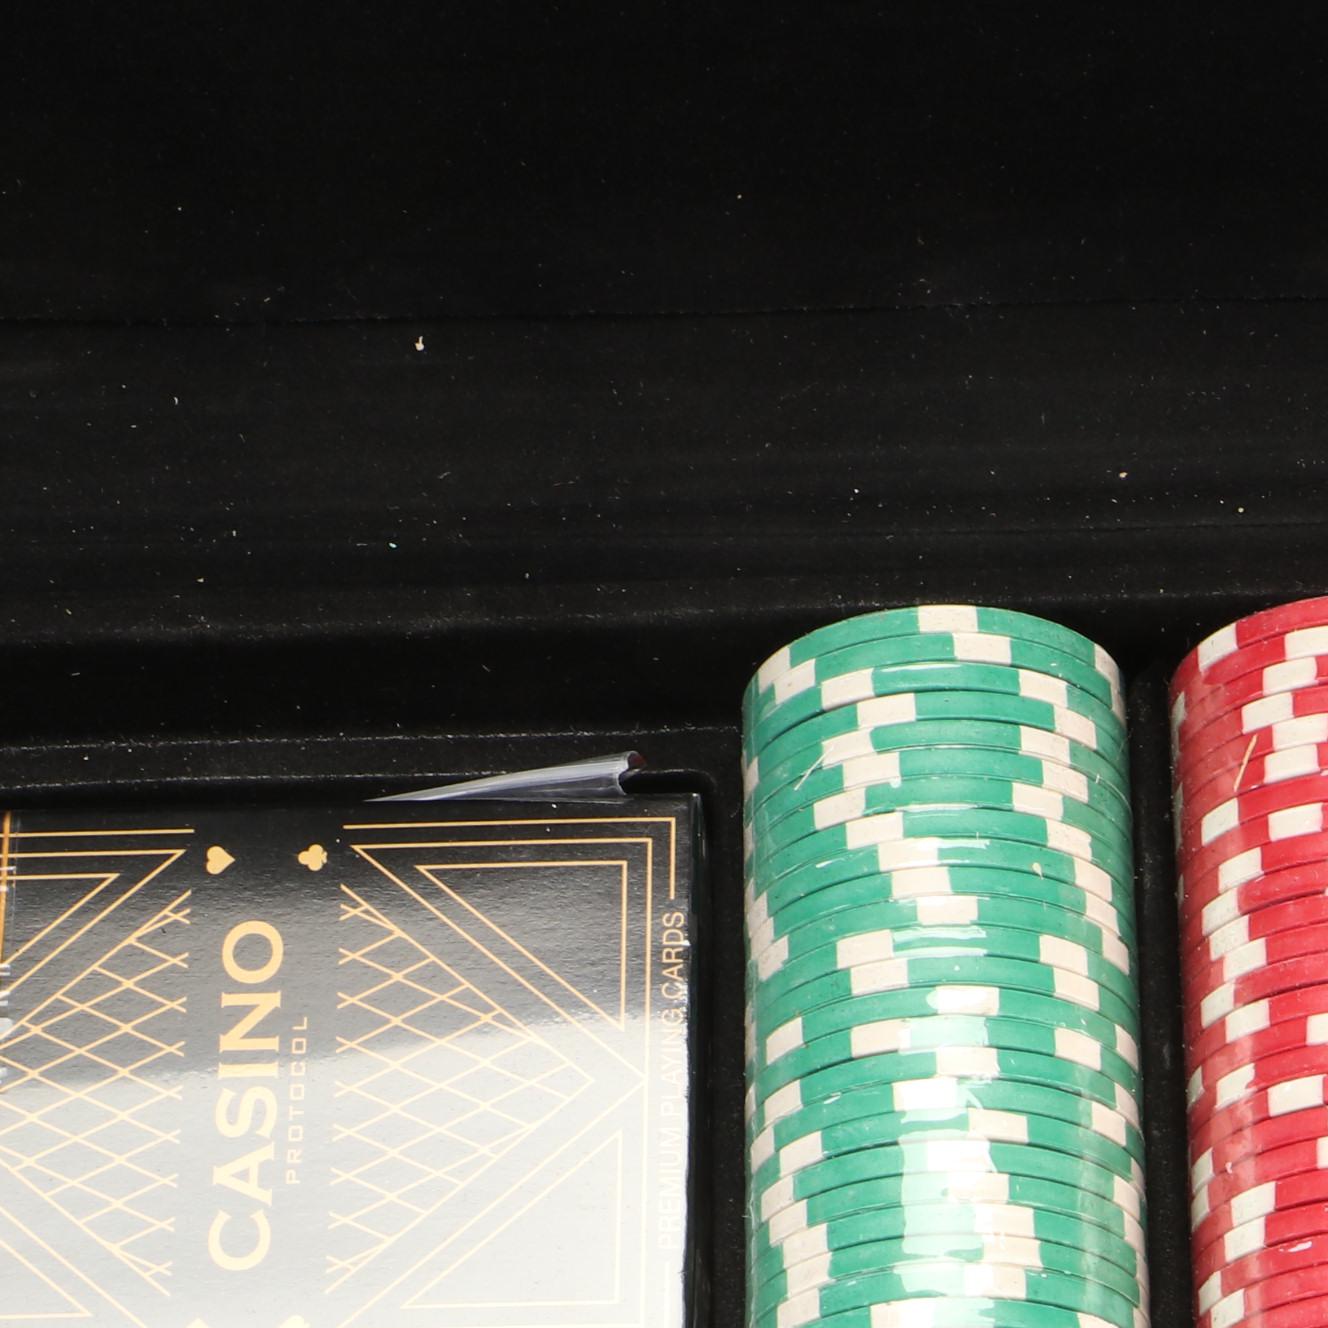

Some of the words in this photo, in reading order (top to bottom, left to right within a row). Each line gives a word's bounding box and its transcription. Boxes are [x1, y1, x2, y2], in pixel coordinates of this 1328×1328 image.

[661, 911, 685, 999] CARDS
[209, 920, 284, 1271] CASINO
[286, 1016, 309, 1185] PROTOCOL
[660, 1008, 685, 1116] PLAYING
[658, 1127, 683, 1250] PREMIUM
